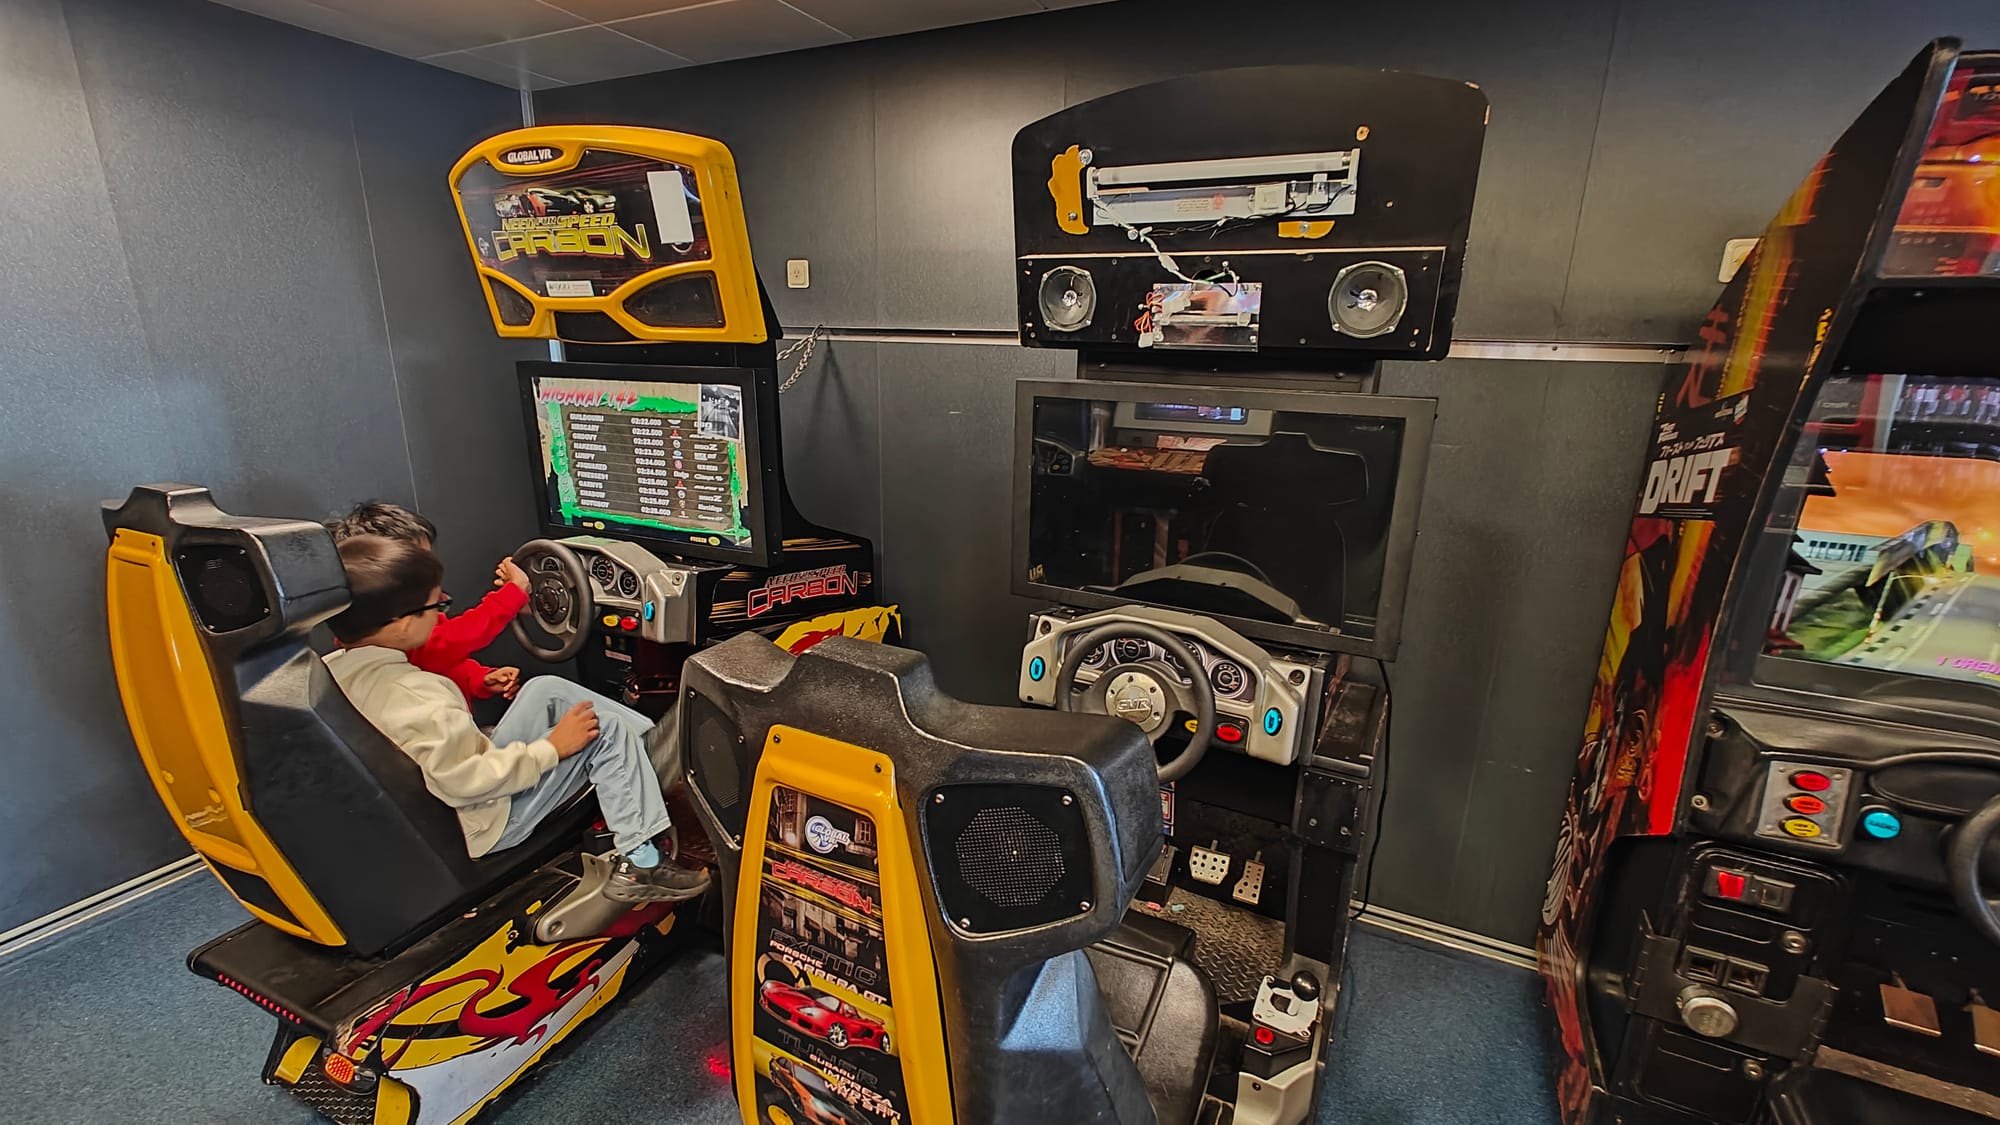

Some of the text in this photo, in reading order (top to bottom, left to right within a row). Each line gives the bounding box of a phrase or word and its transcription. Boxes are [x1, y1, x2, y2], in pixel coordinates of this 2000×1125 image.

[507, 148, 552, 163] GLOBAL VR
[502, 217, 536, 231] NEED
[556, 212, 616, 228] SPEED
[491, 223, 652, 262] CARBON
[540, 388, 605, 407] HIGHWAY
[1639, 448, 1732, 514] DRIFT
[747, 570, 859, 618] CARBON
[813, 824, 851, 844] GLOBAL
[771, 861, 872, 915] CARBON
[769, 940, 824, 969] PORSCHE
[769, 927, 877, 986] EXOTIC
[782, 954, 888, 1005] CARRERA GT
[809, 1053, 856, 1080] SUBARU
[823, 1067, 893, 1109] IMPREZA
